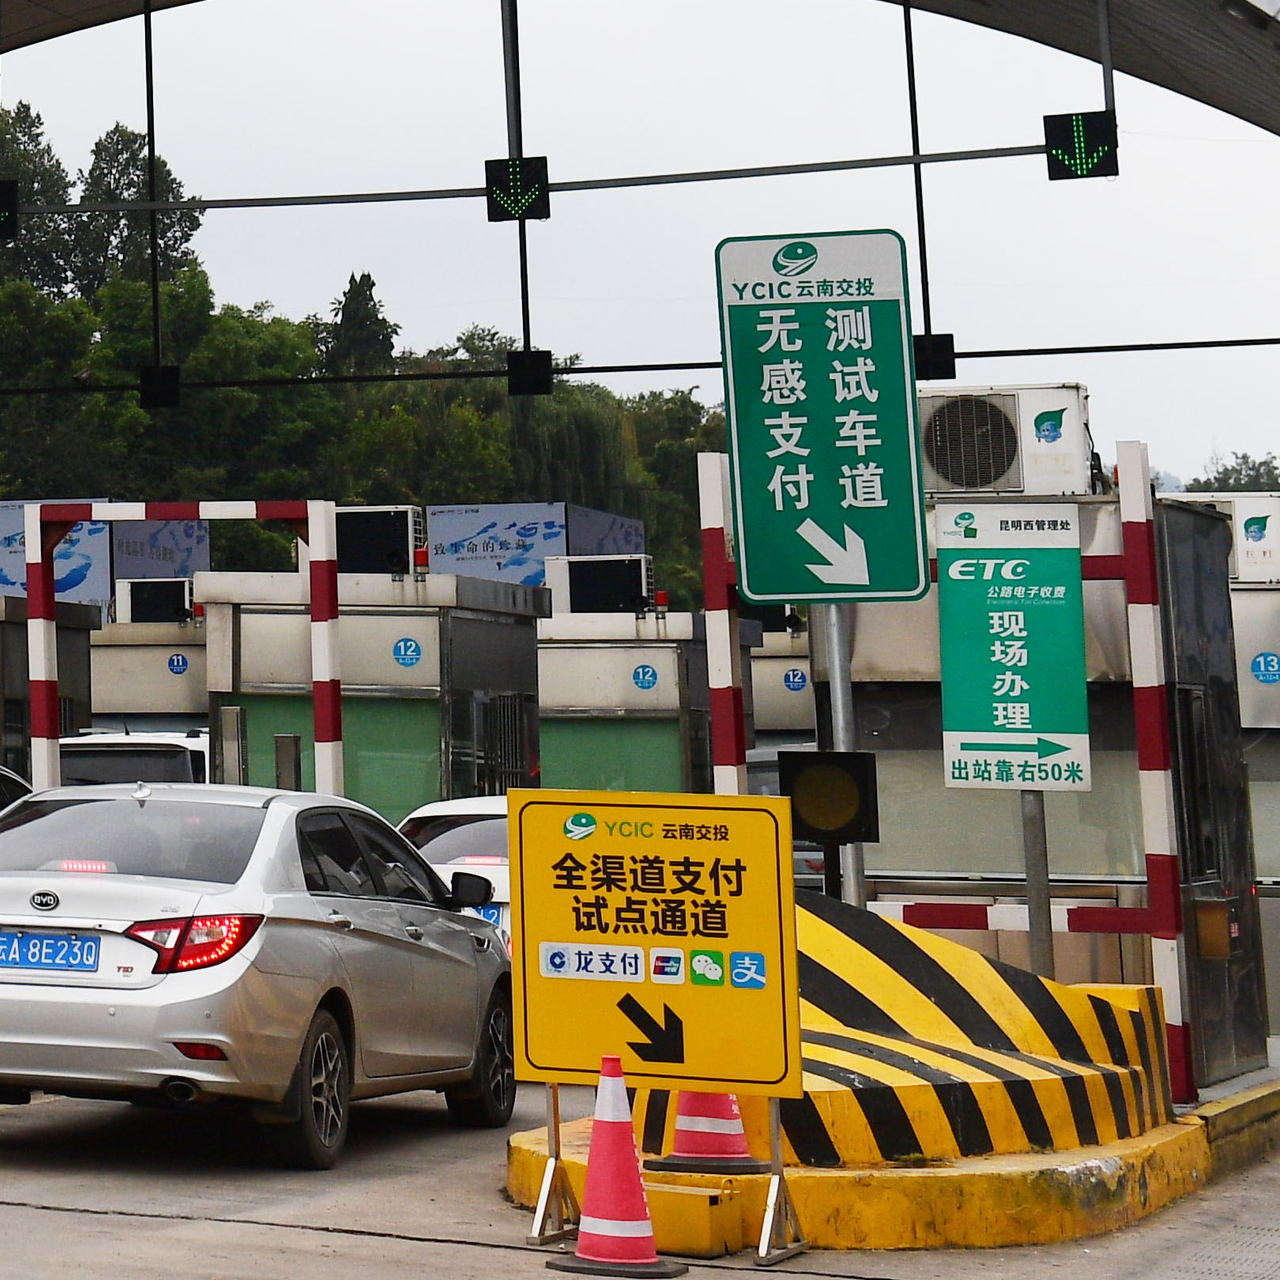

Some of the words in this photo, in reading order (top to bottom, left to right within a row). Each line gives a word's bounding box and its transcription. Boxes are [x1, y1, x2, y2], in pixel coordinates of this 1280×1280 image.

[732, 281, 792, 300] YCIC
[796, 278, 875, 297] 云南交投
[757, 308, 814, 511] 无感支付
[824, 306, 888, 508] 测试车道
[999, 519, 1071, 532] 昆明西管理处
[948, 559, 1031, 580] ETC
[987, 586, 1066, 599] 公路电子收费
[397, 641, 417, 655] 12
[172, 655, 182, 666] 11
[988, 611, 1032, 729] 现场办理
[1256, 655, 1279, 671] 13
[636, 667, 653, 680] 12
[787, 671, 802, 682] 12
[951, 759, 1083, 783] 出站靠右50米
[603, 821, 654, 839] YCIC
[661, 823, 729, 842] 云南交投
[551, 852, 747, 897] 全渠道支付
[571, 895, 729, 939] 试点通道
[574, 951, 640, 976] 龙支付
